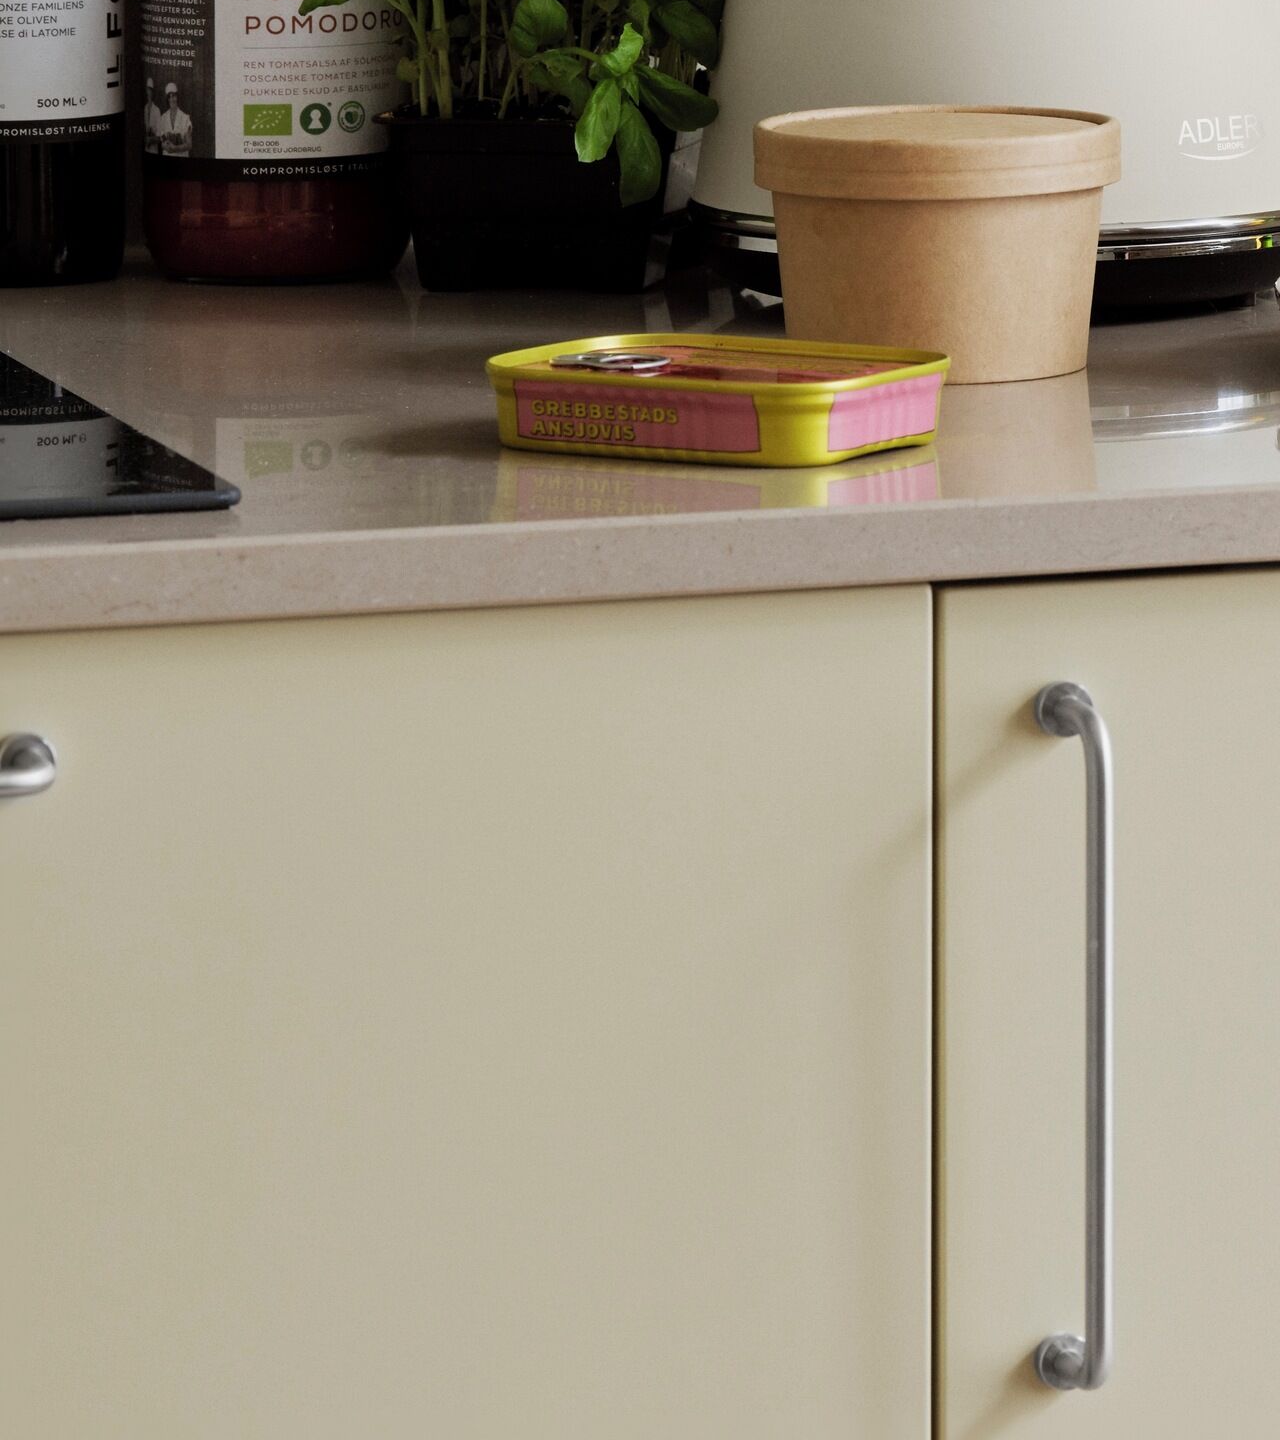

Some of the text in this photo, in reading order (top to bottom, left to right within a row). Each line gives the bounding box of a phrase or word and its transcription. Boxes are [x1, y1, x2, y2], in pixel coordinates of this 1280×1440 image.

[31, 0, 84, 11] FAMILIENS
[161, 6, 181, 14] EFTER
[17, 15, 57, 25] OLIVEN
[163, 17, 206, 26] GENVUNDET
[18, 29, 28, 38] di
[31, 27, 76, 37] LATOMIE
[159, 26, 186, 36] FLASKES
[160, 48, 196, 57] KRYDREDE
[243, 61, 265, 69] REN
[269, 60, 337, 69] TOMATSALSA
[340, 58, 350, 66] AF
[243, 73, 308, 83] TOSCANSKE
[311, 71, 358, 81] TOMATER
[362, 68, 379, 78] MED
[243, 88, 300, 97] PLUKKEDE
[303, 86, 330, 95] SKUD
[333, 85, 346, 94] AF
[37, 98, 59, 108] 500
[62, 97, 77, 107] ML
[1178, 114, 1261, 145] ADLER
[242, 164, 344, 175] KOMPROMISLØST
[530, 398, 679, 425] GREBBESTADS
[530, 420, 637, 442] ANSJOVIS
